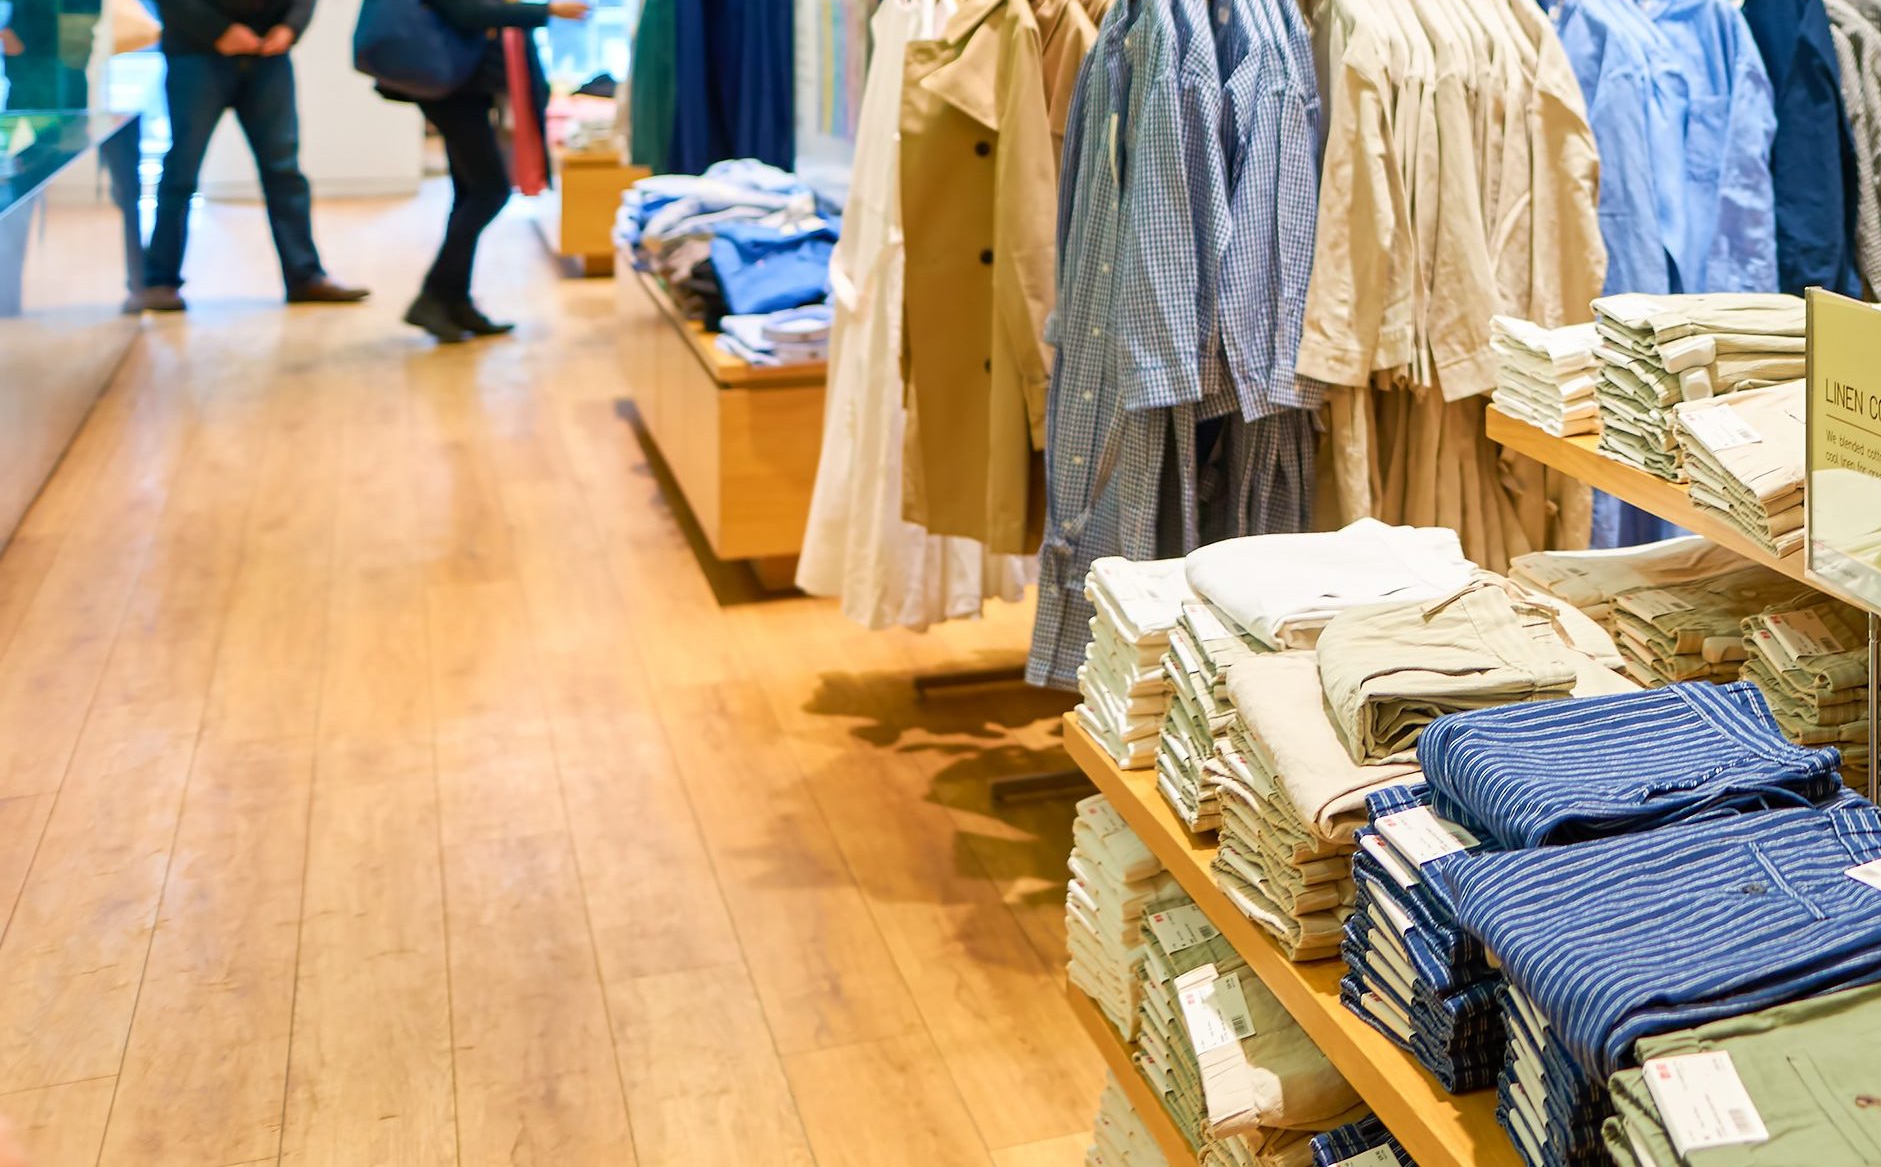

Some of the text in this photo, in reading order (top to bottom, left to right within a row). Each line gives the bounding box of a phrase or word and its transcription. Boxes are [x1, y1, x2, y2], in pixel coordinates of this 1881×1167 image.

[1825, 378, 1863, 415] LINEN
[1825, 428, 1837, 444] We
[1839, 433, 1864, 456] blended
[1825, 451, 1838, 464] cool
